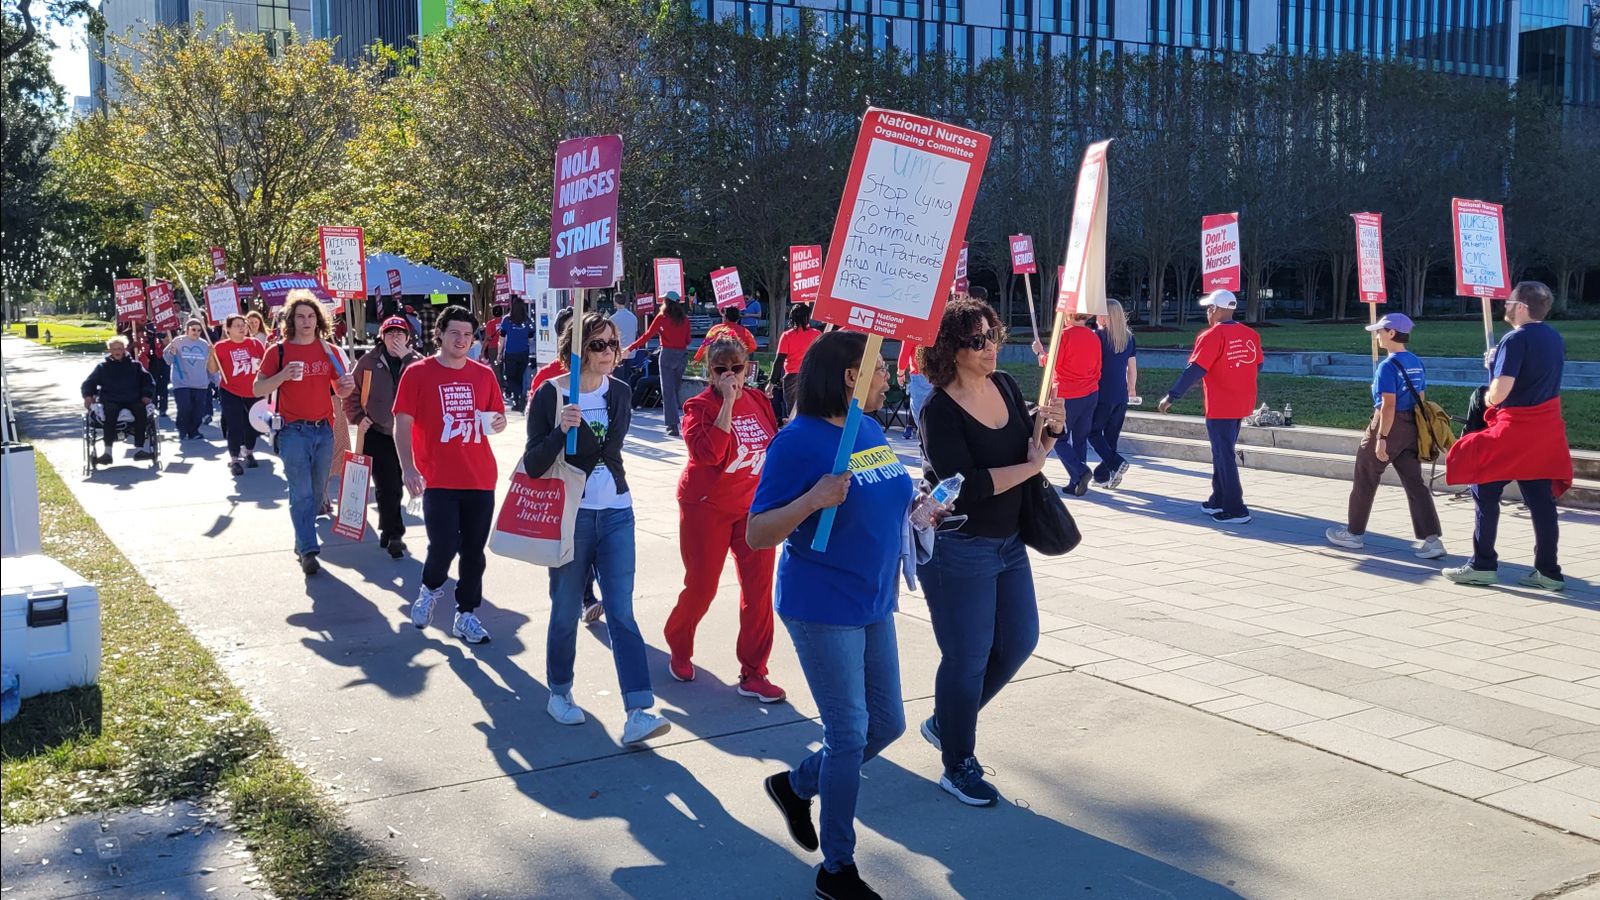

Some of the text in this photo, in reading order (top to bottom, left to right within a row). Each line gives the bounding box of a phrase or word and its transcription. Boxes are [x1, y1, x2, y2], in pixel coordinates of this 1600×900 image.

[878, 114, 978, 148] National Nurses
[875, 126, 974, 158] Organizing Committee
[561, 146, 600, 181] NOLA
[894, 146, 945, 184] UMC
[559, 168, 615, 208] NURSES
[562, 209, 575, 226] ON
[858, 198, 918, 227] To the
[325, 237, 357, 249] PATIENTS
[556, 216, 611, 258] STRIKE
[854, 216, 945, 255] Community
[1206, 229, 1226, 245] Don't
[792, 250, 812, 262] NOLA
[849, 236, 888, 257] That
[890, 242, 942, 268] Patients
[1206, 240, 1236, 258] Sideline
[792, 258, 819, 272] NURSES
[845, 254, 869, 270] AND
[1206, 255, 1232, 270] Nurses
[260, 278, 318, 291] RETENTION
[328, 271, 352, 282] SHAKE
[793, 275, 820, 291] STRIKE
[840, 269, 872, 290] ARE
[118, 301, 144, 315] STRIKE
[875, 318, 897, 329] Nurses
[877, 312, 904, 324] National
[874, 325, 896, 335] United
[853, 469, 881, 486] FOR
[510, 482, 561, 501] Research
[516, 496, 553, 510] Power
[516, 509, 560, 524] Justice
